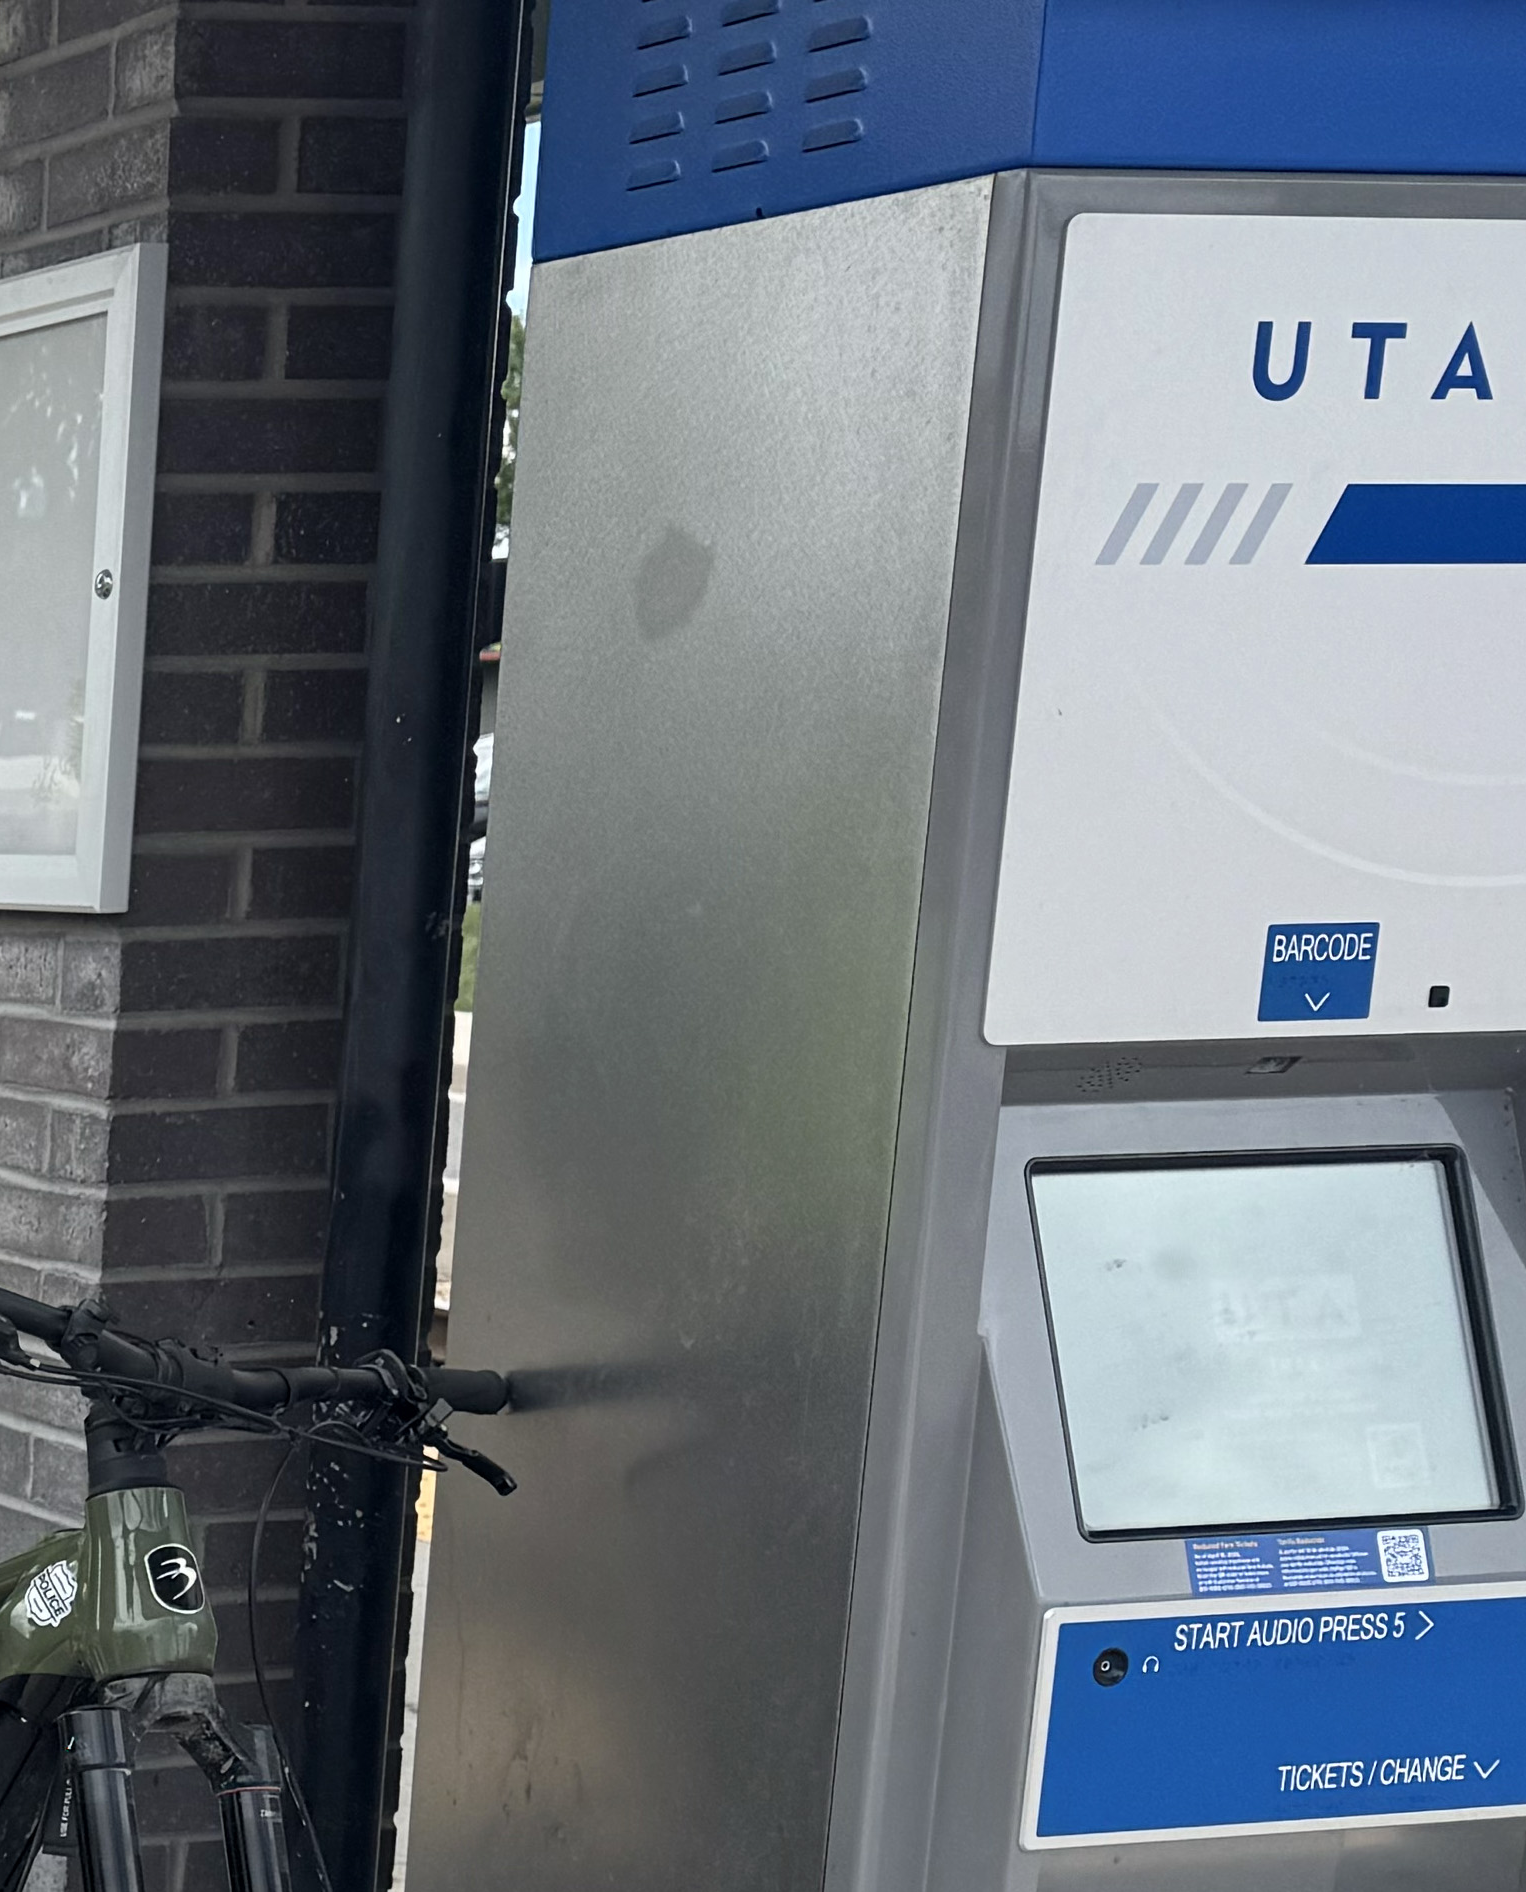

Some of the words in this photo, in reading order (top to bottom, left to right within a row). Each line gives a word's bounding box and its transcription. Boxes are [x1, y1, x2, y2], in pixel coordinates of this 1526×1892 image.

[1252, 320, 1494, 402] UTA
[1271, 932, 1375, 965] BARCODE
[38, 1573, 66, 1617] POLICE
[1173, 1620, 1245, 1652] START
[1246, 1617, 1314, 1647] AUDIO
[1318, 1613, 1389, 1643] PRESS
[1392, 1611, 1407, 1639] 5
[1277, 1760, 1364, 1792] TICKETS
[1380, 1753, 1467, 1785] CHANGE
